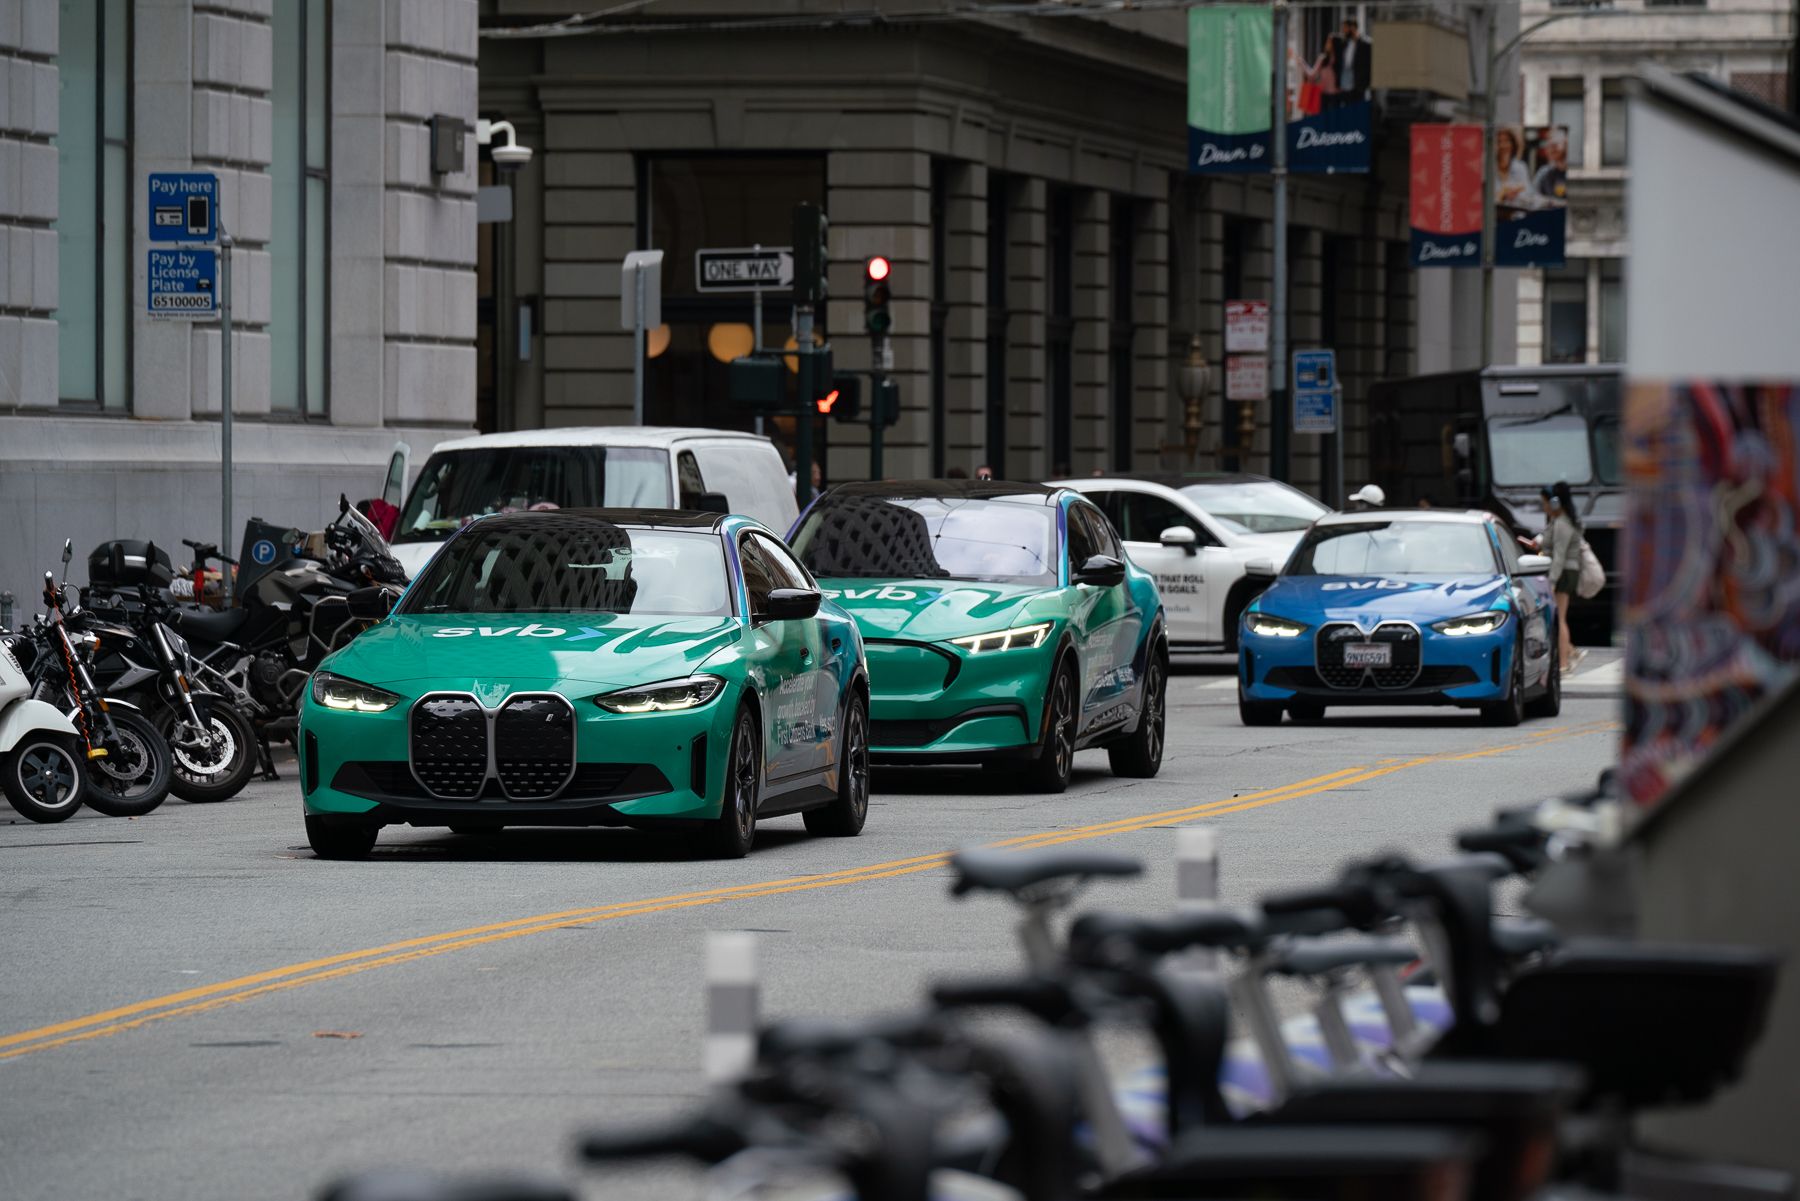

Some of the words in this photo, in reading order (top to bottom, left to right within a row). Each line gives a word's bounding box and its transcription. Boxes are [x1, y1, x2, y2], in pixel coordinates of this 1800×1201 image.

[152, 179, 177, 196] Pay
[180, 178, 212, 193] here
[152, 252, 175, 268] Pay
[179, 251, 195, 268] by
[152, 265, 200, 278] License
[708, 262, 740, 280] ONE
[747, 261, 781, 278] WAY
[152, 279, 185, 292] Plate
[154, 296, 210, 308] 65100005
[1160, 574, 1181, 584] THAT
[1183, 574, 1205, 585] ROLL
[820, 586, 917, 601] svb
[1167, 585, 1198, 595] GOALS.
[432, 624, 567, 638] svb
